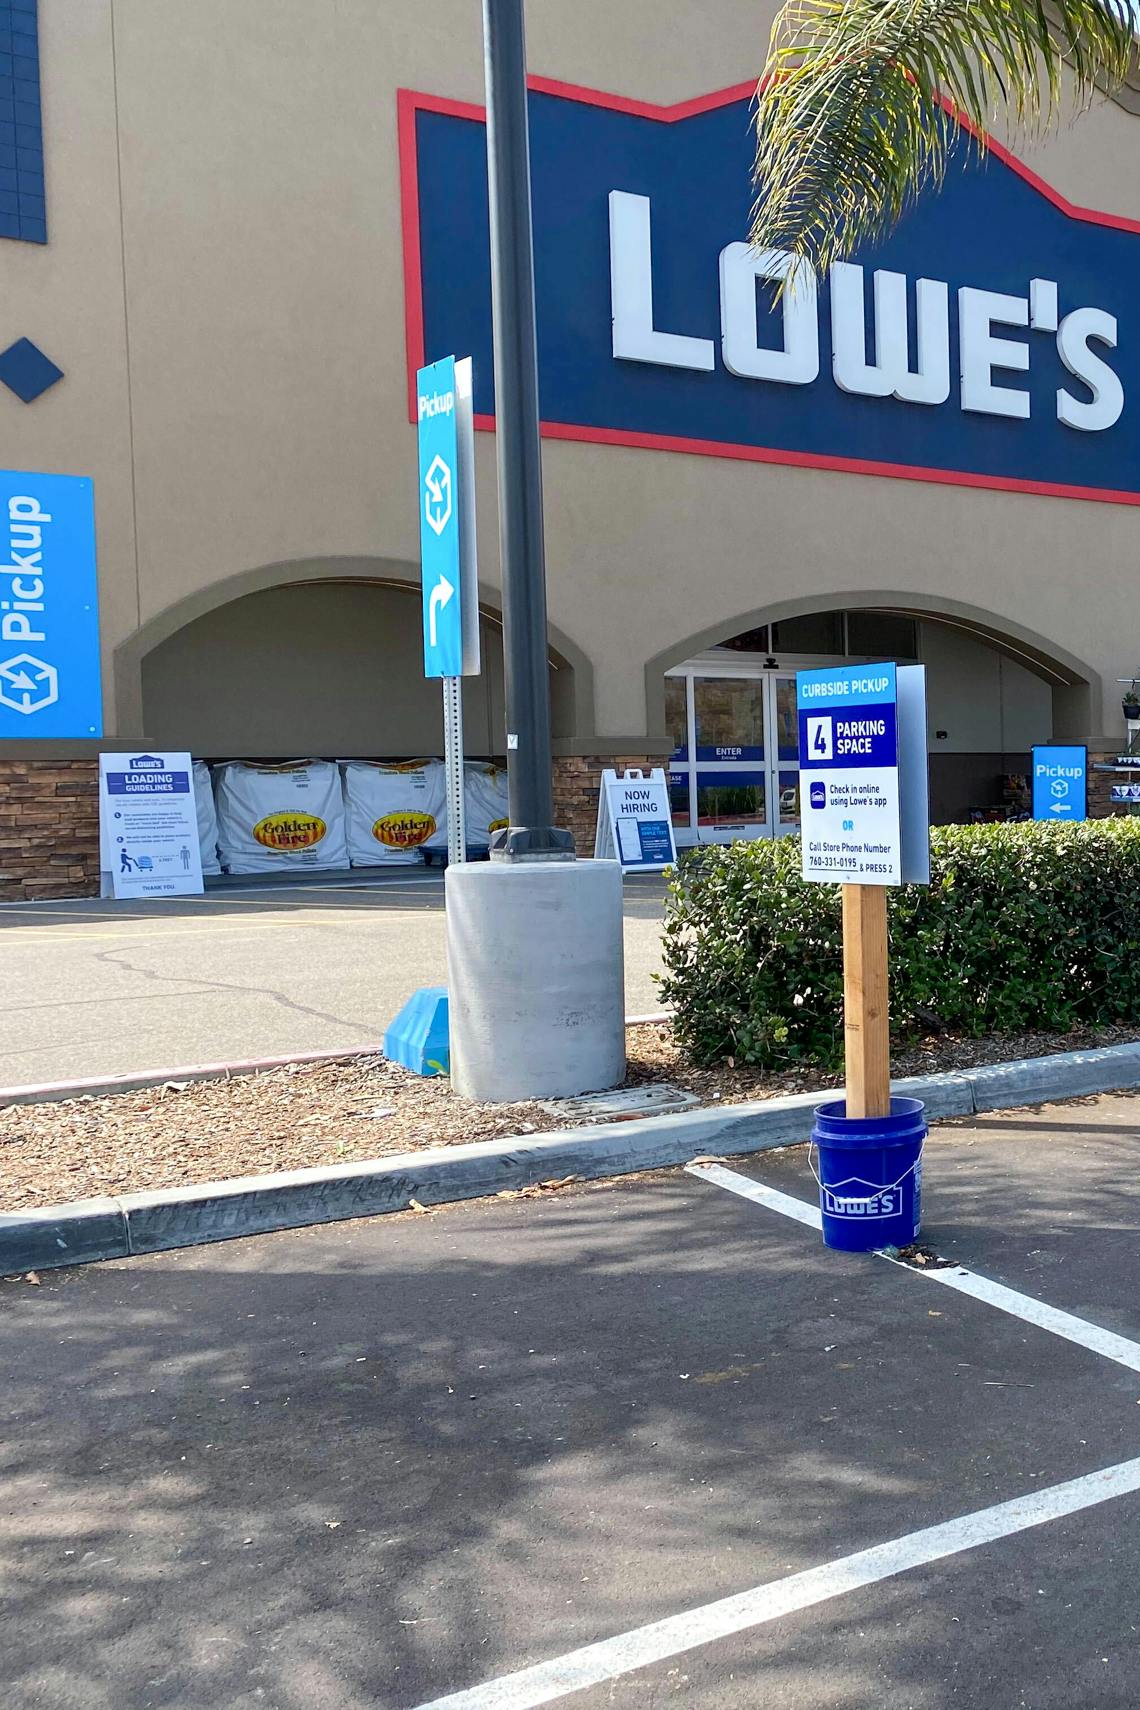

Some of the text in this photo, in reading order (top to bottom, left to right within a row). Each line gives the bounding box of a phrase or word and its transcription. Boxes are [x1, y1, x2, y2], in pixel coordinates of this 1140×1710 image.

[608, 190, 1125, 431] LOWE'S
[419, 391, 453, 421] Pickup
[0, 495, 51, 641] Pickup
[802, 677, 889, 698] CURBSIDE PICKUP
[836, 720, 886, 738] PARKING
[814, 724, 826, 754] 4
[716, 747, 742, 756] ENTER
[837, 738, 873, 755] SPACE
[132, 760, 161, 768] LOWE'S
[1036, 764, 1083, 779] Pickup
[125, 774, 173, 784] LOADING
[125, 783, 174, 792] GUIDELINES
[829, 783, 880, 794] Check in online
[624, 790, 650, 801] NOW
[830, 796, 848, 808] using
[849, 796, 873, 806] Lowe's
[874, 797, 888, 808] app
[621, 802, 658, 813] HIRING
[262, 820, 319, 834] Golden
[380, 819, 431, 833] Golden
[842, 820, 854, 831] OR
[277, 833, 310, 845] Fire
[393, 831, 422, 843] Fire
[809, 841, 891, 854] Call Store Phone Number
[809, 856, 893, 873] 760-331-0195 & PRESS 2
[826, 1188, 894, 1214] LOWE'S
